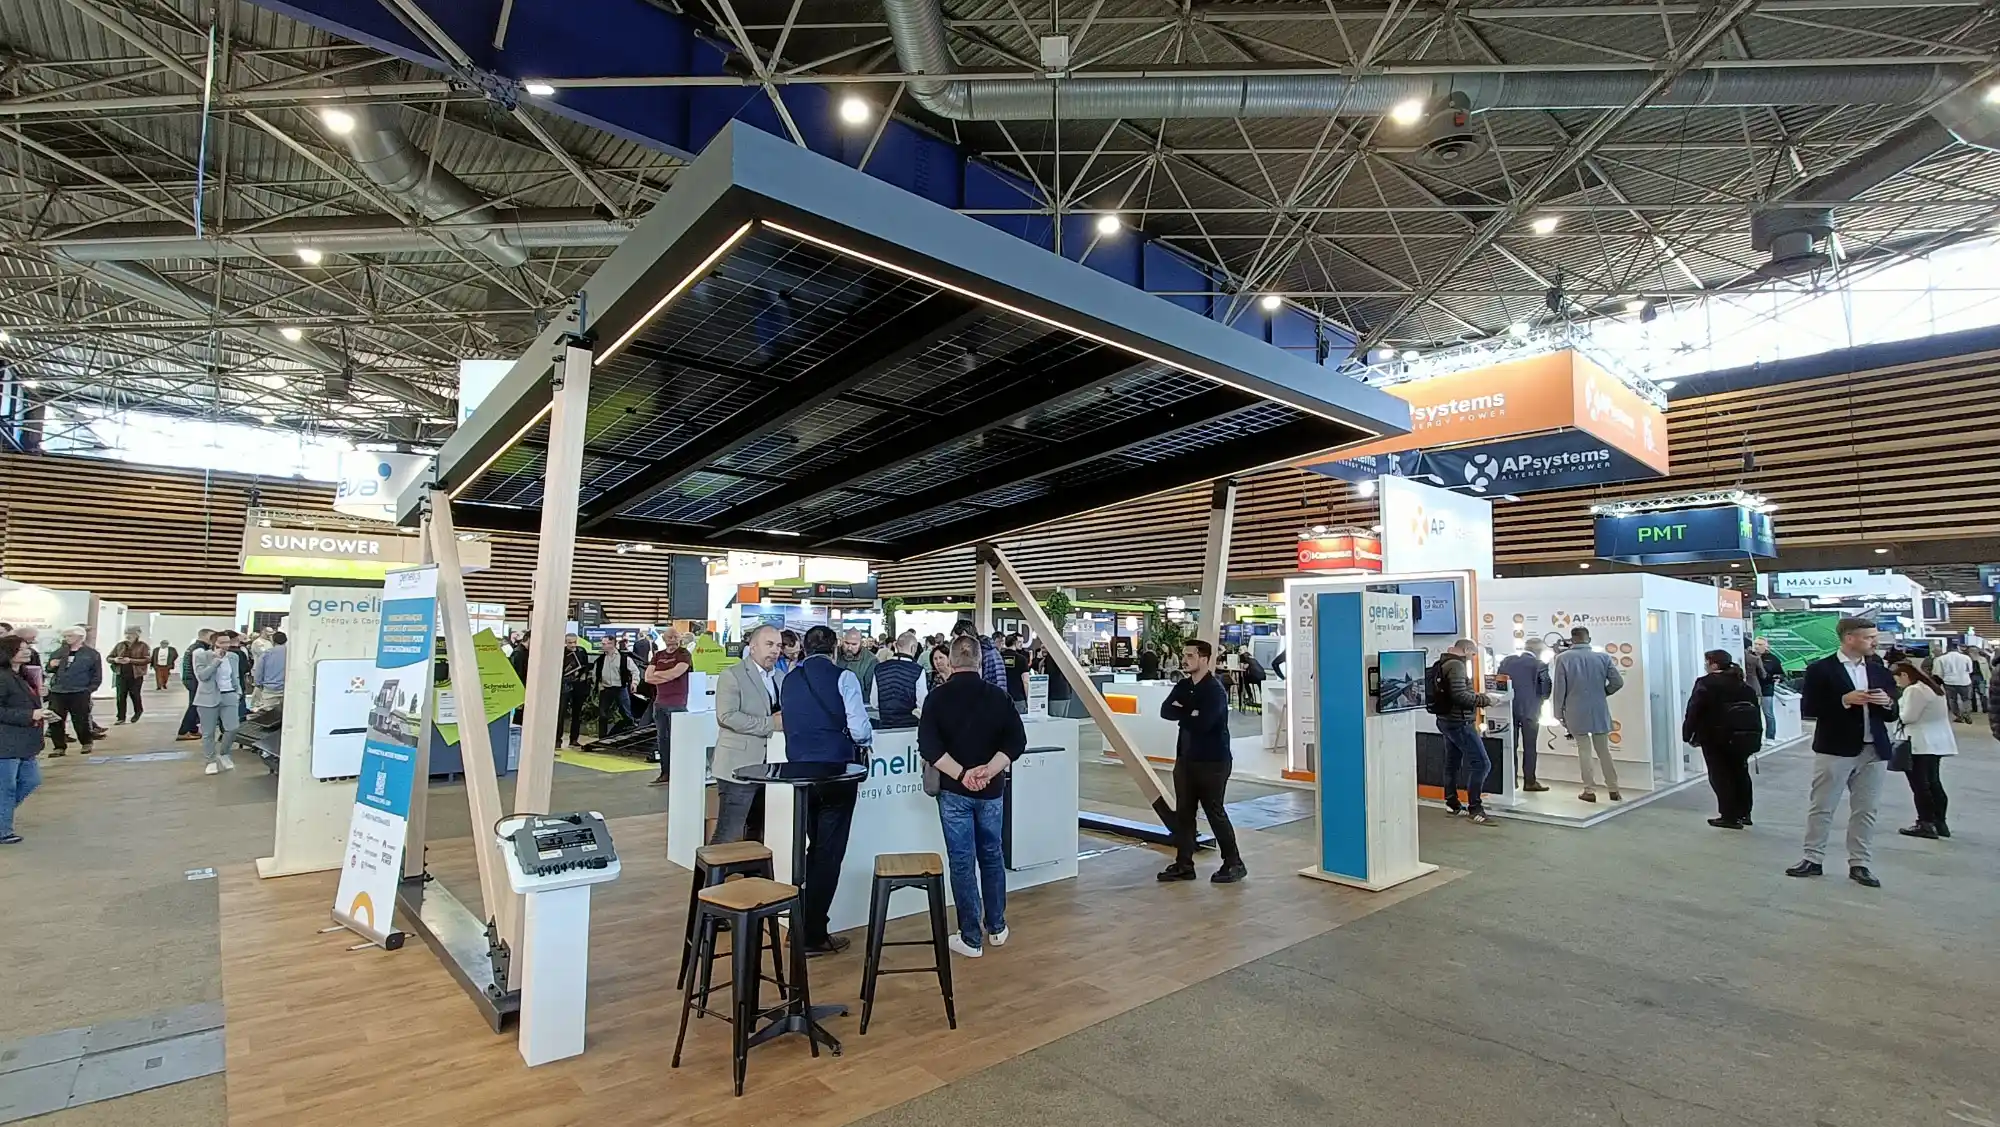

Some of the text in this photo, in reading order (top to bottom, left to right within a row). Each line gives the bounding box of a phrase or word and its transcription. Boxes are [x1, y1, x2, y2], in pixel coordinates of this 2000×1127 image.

[1501, 449, 1610, 473] APsystems
[1501, 461, 1611, 481] ALTENERGY POWER
[1637, 524, 1688, 543] PMT
[260, 533, 380, 555] SUNPOWER
[1369, 602, 1409, 623] genelios
[1572, 613, 1632, 623] APsystems
[483, 683, 516, 691] Schneider
[886, 784, 892, 795] &
